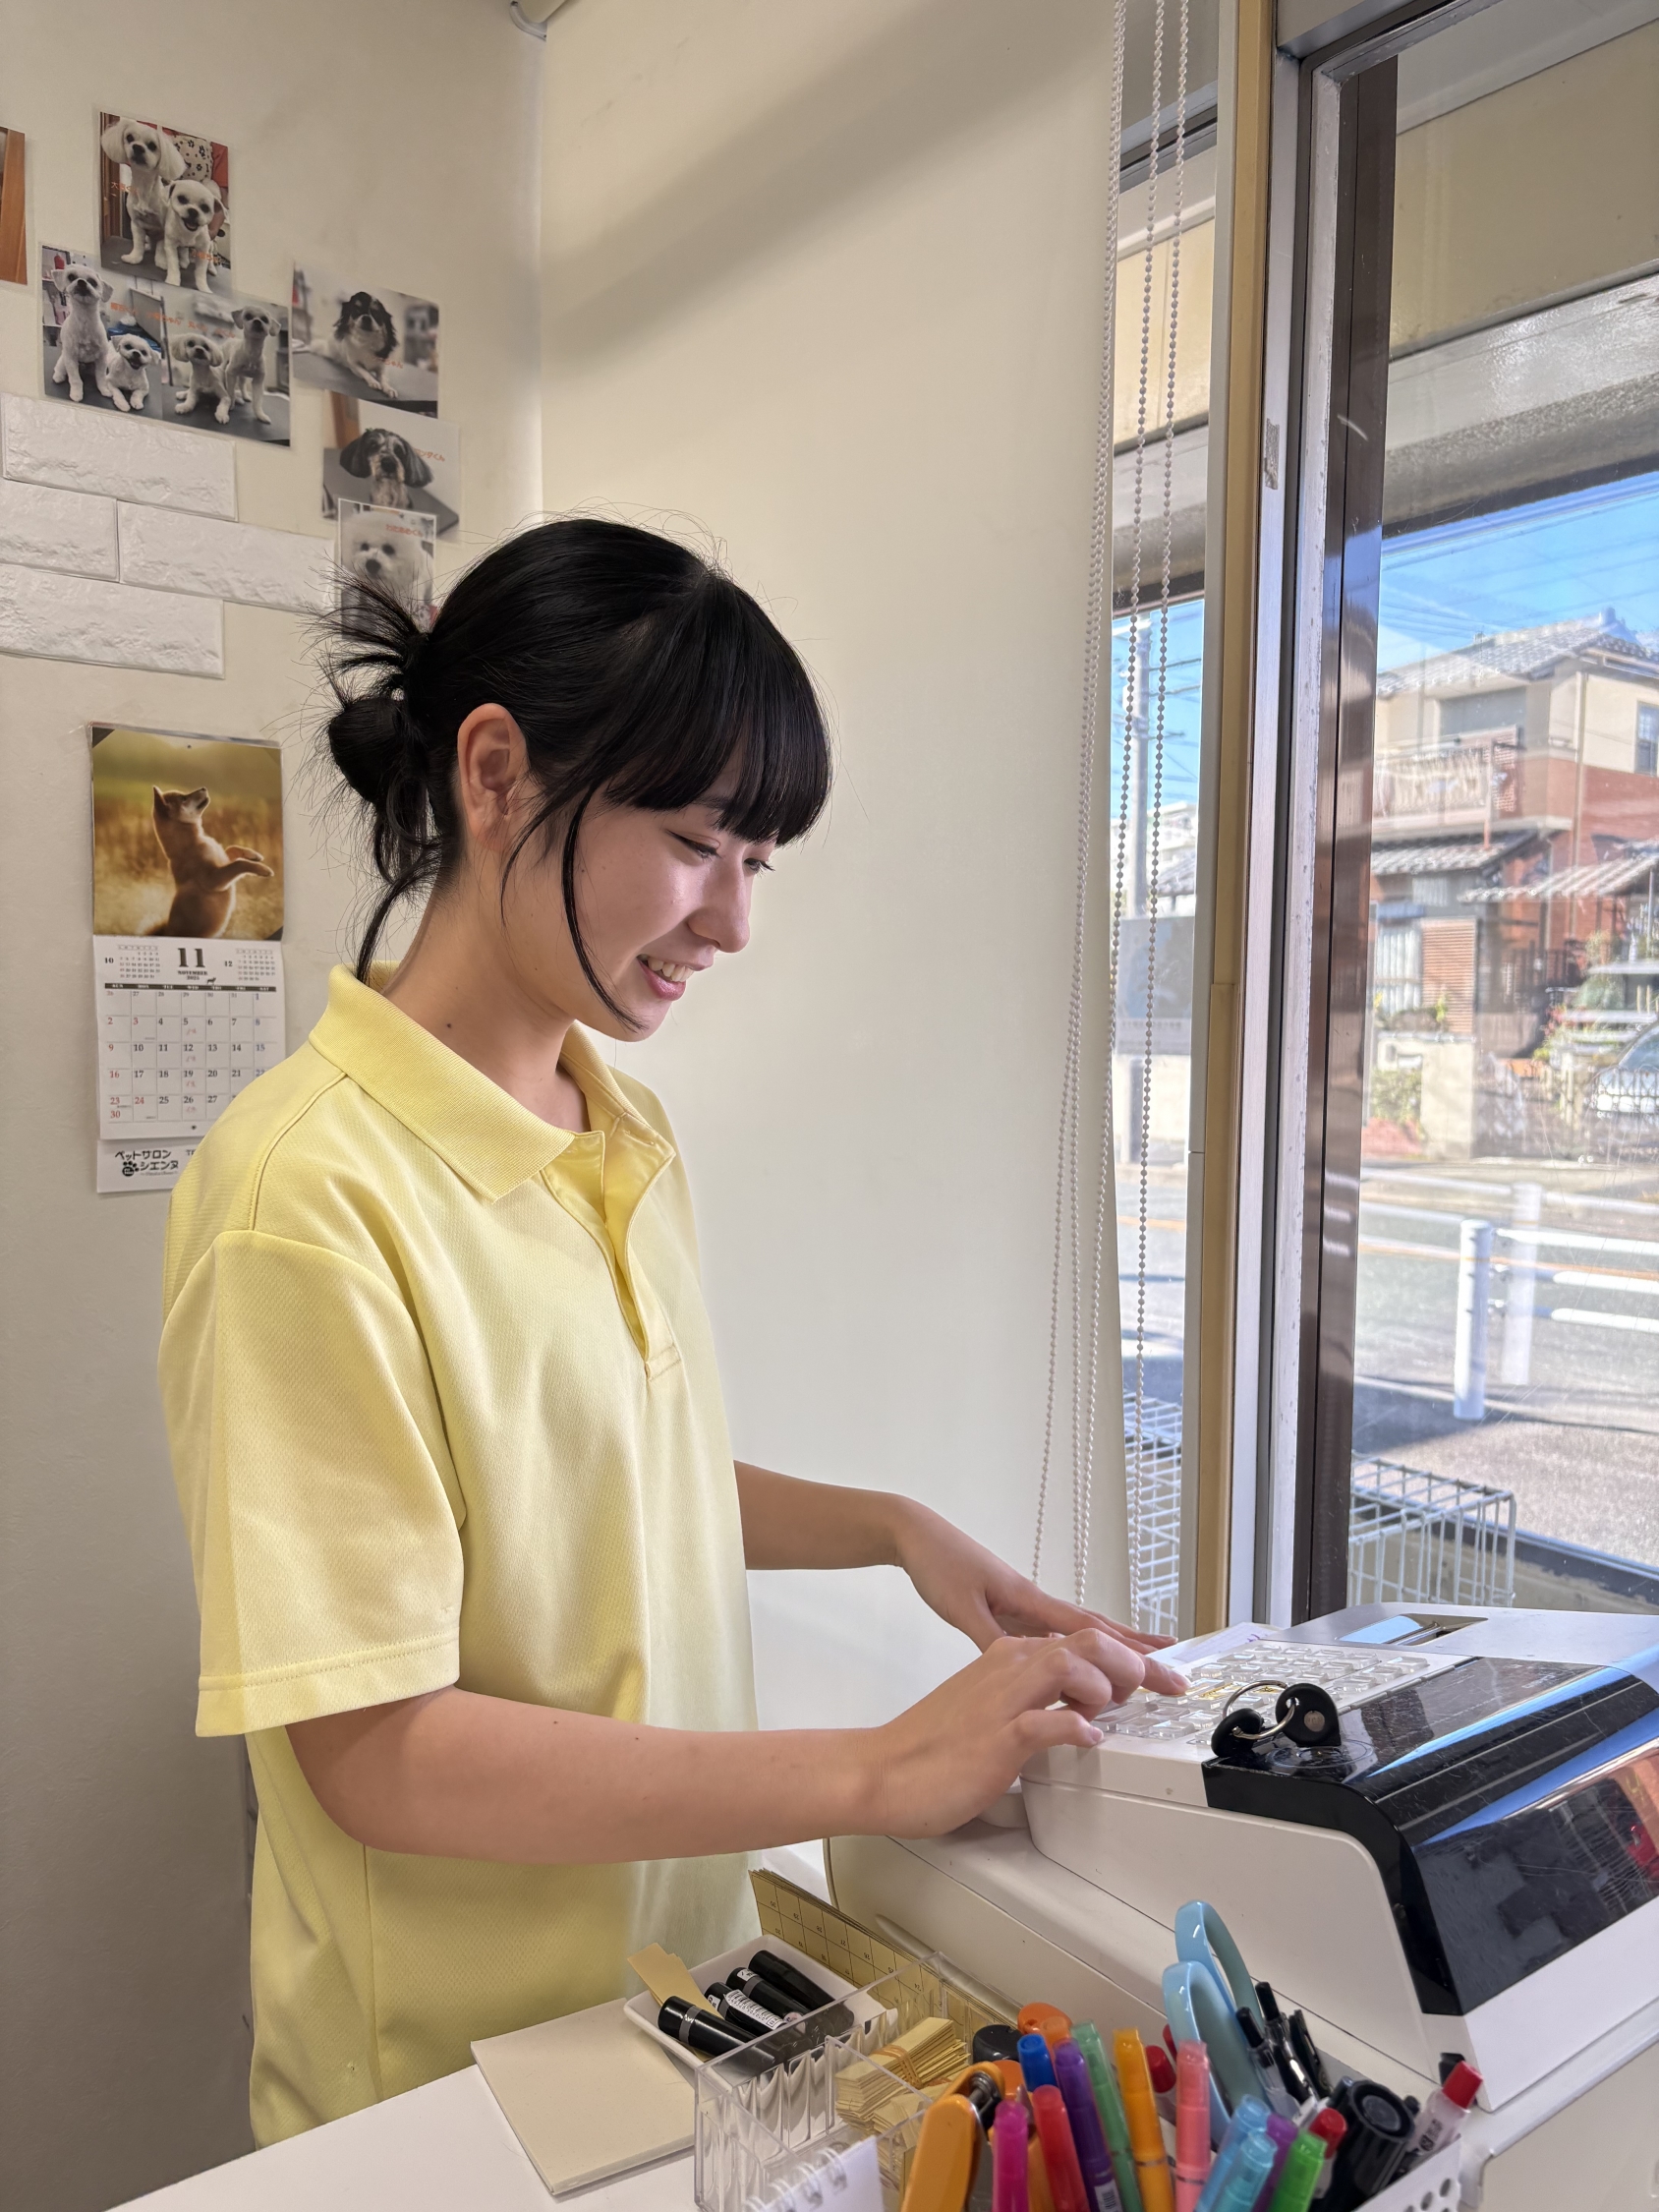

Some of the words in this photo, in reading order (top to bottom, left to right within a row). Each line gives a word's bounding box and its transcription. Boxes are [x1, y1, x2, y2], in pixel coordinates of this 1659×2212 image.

[178, 948, 205, 967] 11
[115, 1150, 172, 1161] ペットサロン
